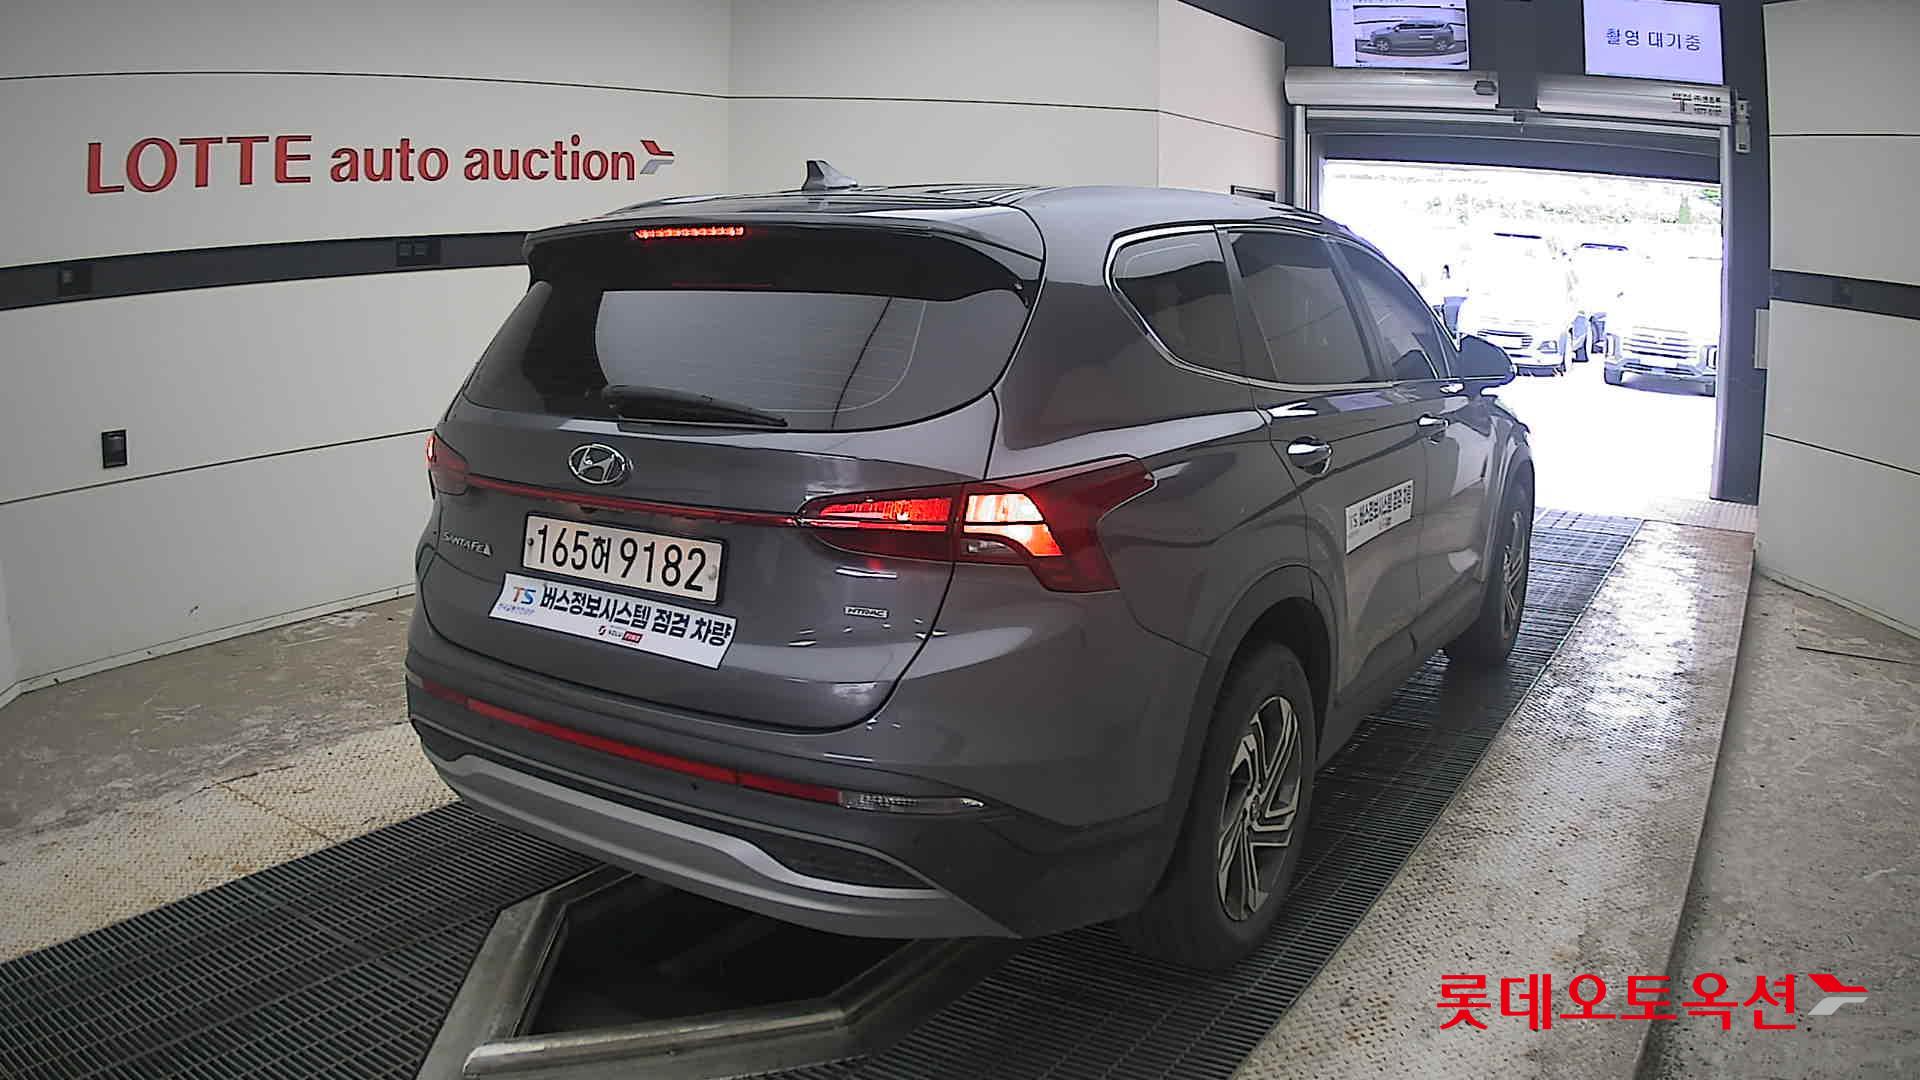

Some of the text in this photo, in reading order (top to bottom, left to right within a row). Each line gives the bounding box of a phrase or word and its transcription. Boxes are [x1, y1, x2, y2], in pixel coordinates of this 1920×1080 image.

[1648, 31, 1700, 51] 대기중
[86, 134, 635, 194] LOTTE auto auction
[620, 537, 707, 592] 9182
[512, 586, 537, 604] TS
[540, 584, 652, 629] 버스정보시스템
[651, 608, 691, 638] 점검
[689, 617, 732, 646] 차량
